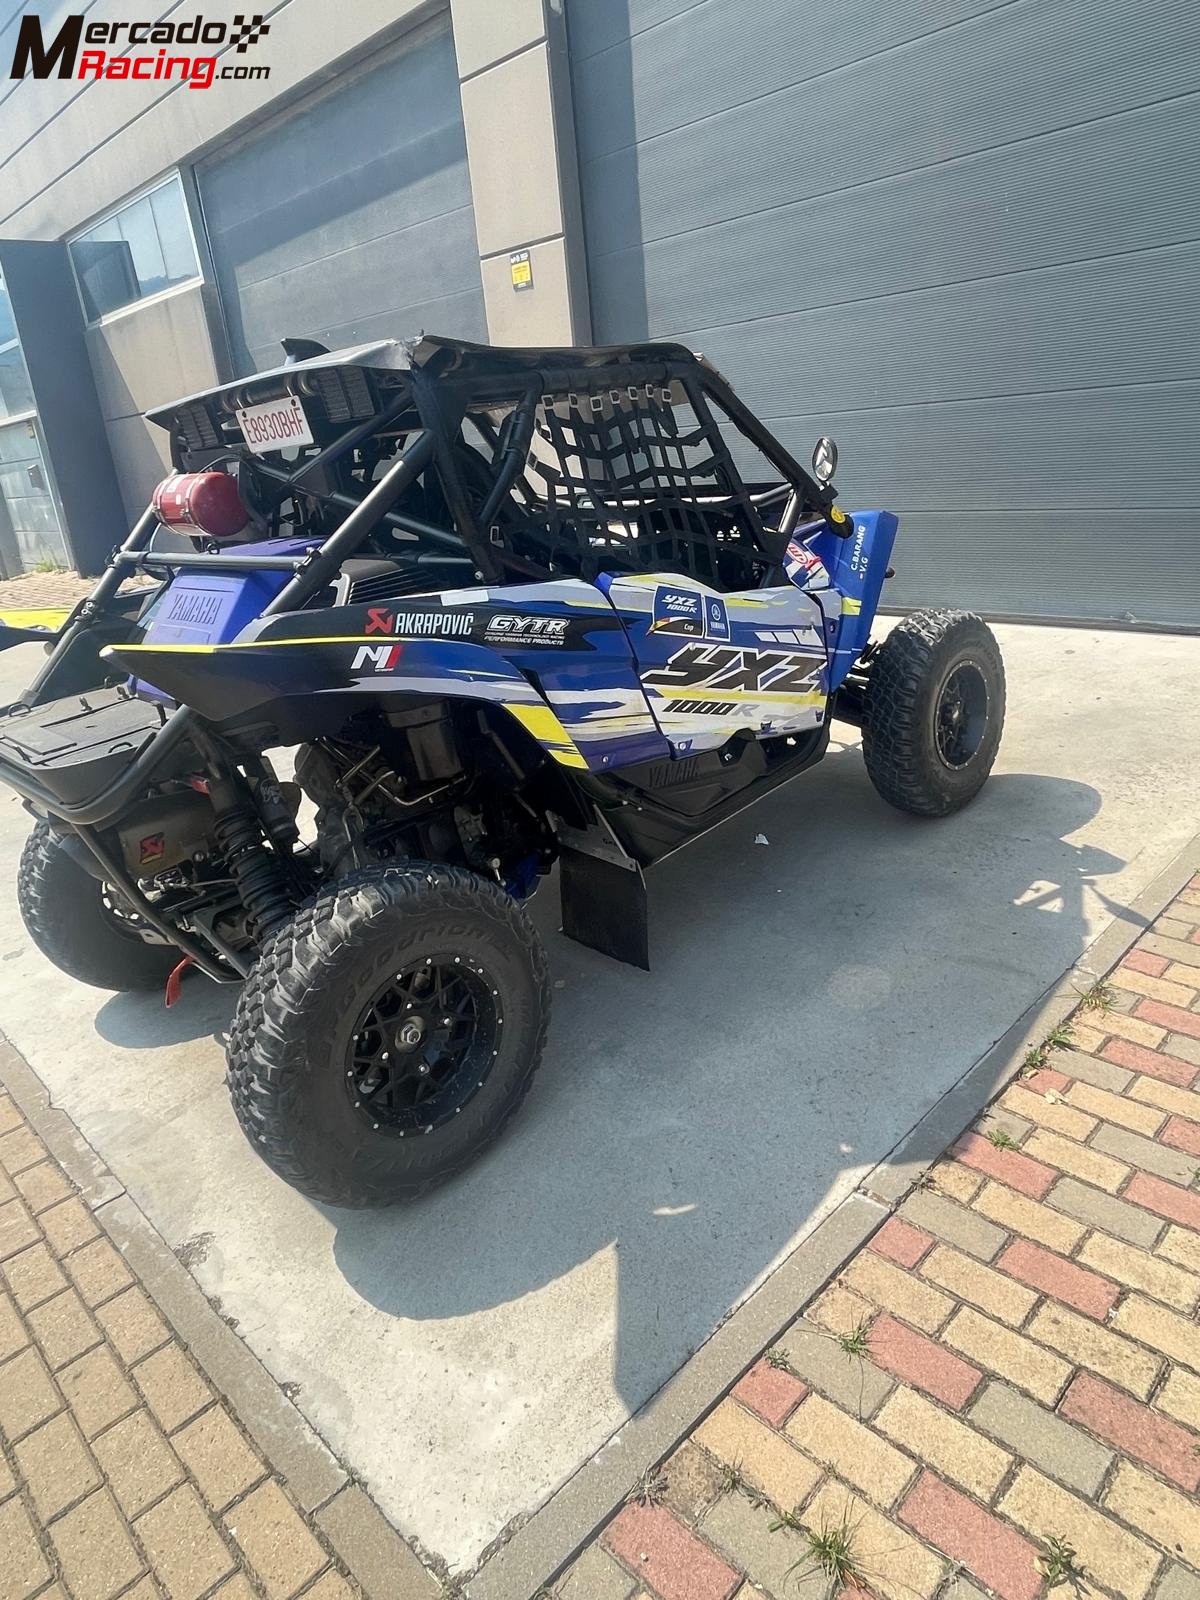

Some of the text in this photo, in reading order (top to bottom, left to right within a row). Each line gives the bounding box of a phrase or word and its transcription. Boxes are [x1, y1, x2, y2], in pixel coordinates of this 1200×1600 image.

[167, 594, 223, 625] YAMAHA
[394, 612, 474, 635] AKRAPOVIČ
[486, 614, 569, 635] GYTR
[640, 643, 827, 693] YXZ
